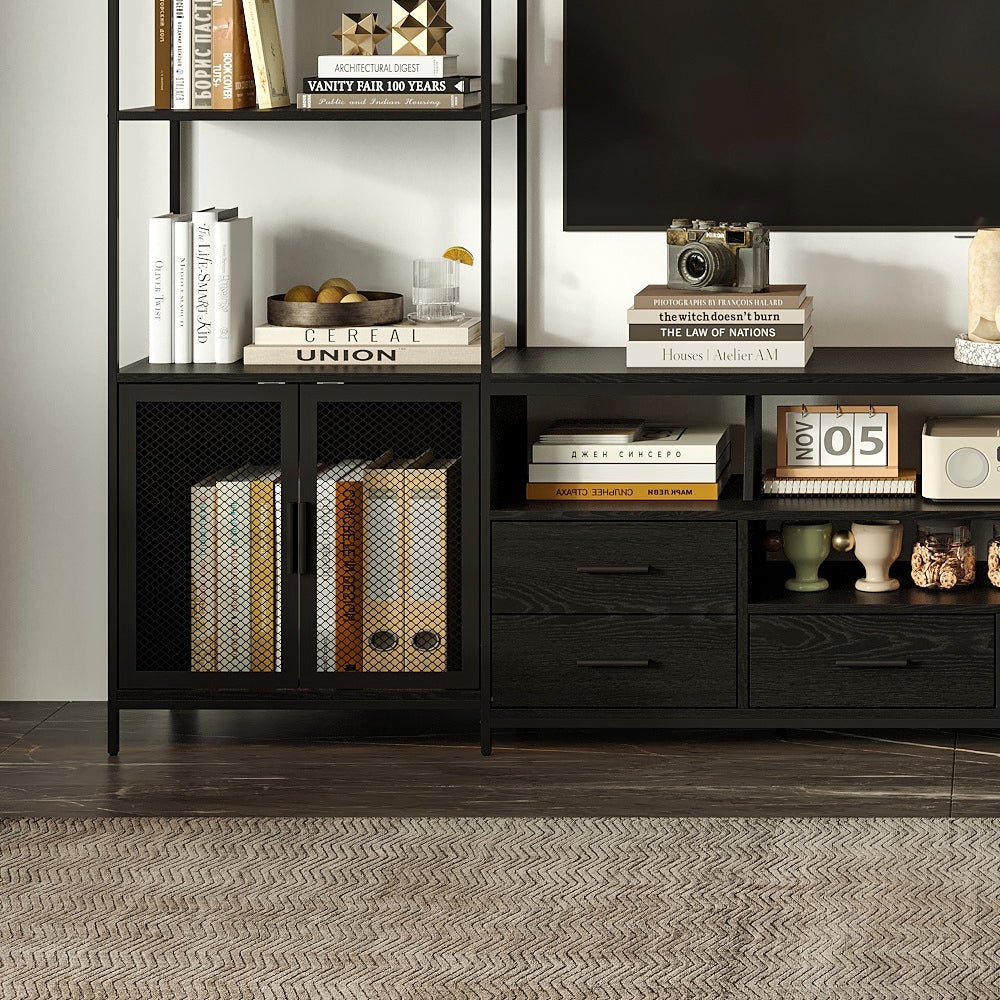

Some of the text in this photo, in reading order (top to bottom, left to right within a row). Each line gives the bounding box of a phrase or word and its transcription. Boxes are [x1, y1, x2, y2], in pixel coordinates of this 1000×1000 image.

[194, 49, 212, 100] БОРИС
[334, 63, 420, 73] ARCHITECTURAL DIGEST
[213, 64, 222, 87] TUTS+
[223, 52, 232, 99] BOOK COVER
[308, 80, 447, 92] VANITY FAIR 100 YEARS
[718, 299, 753, 308] FRANÇOIS
[659, 312, 678, 321] the
[678, 312, 710, 321] witch
[754, 312, 780, 321] burn
[304, 328, 421, 343] CEREAL
[660, 328, 776, 337] THE LAW OF NATIONS
[296, 349, 396, 362] UNION
[662, 348, 778, 361] Houses Atelier AM
[795, 421, 814, 460] NOV
[823, 426, 884, 456] 05
